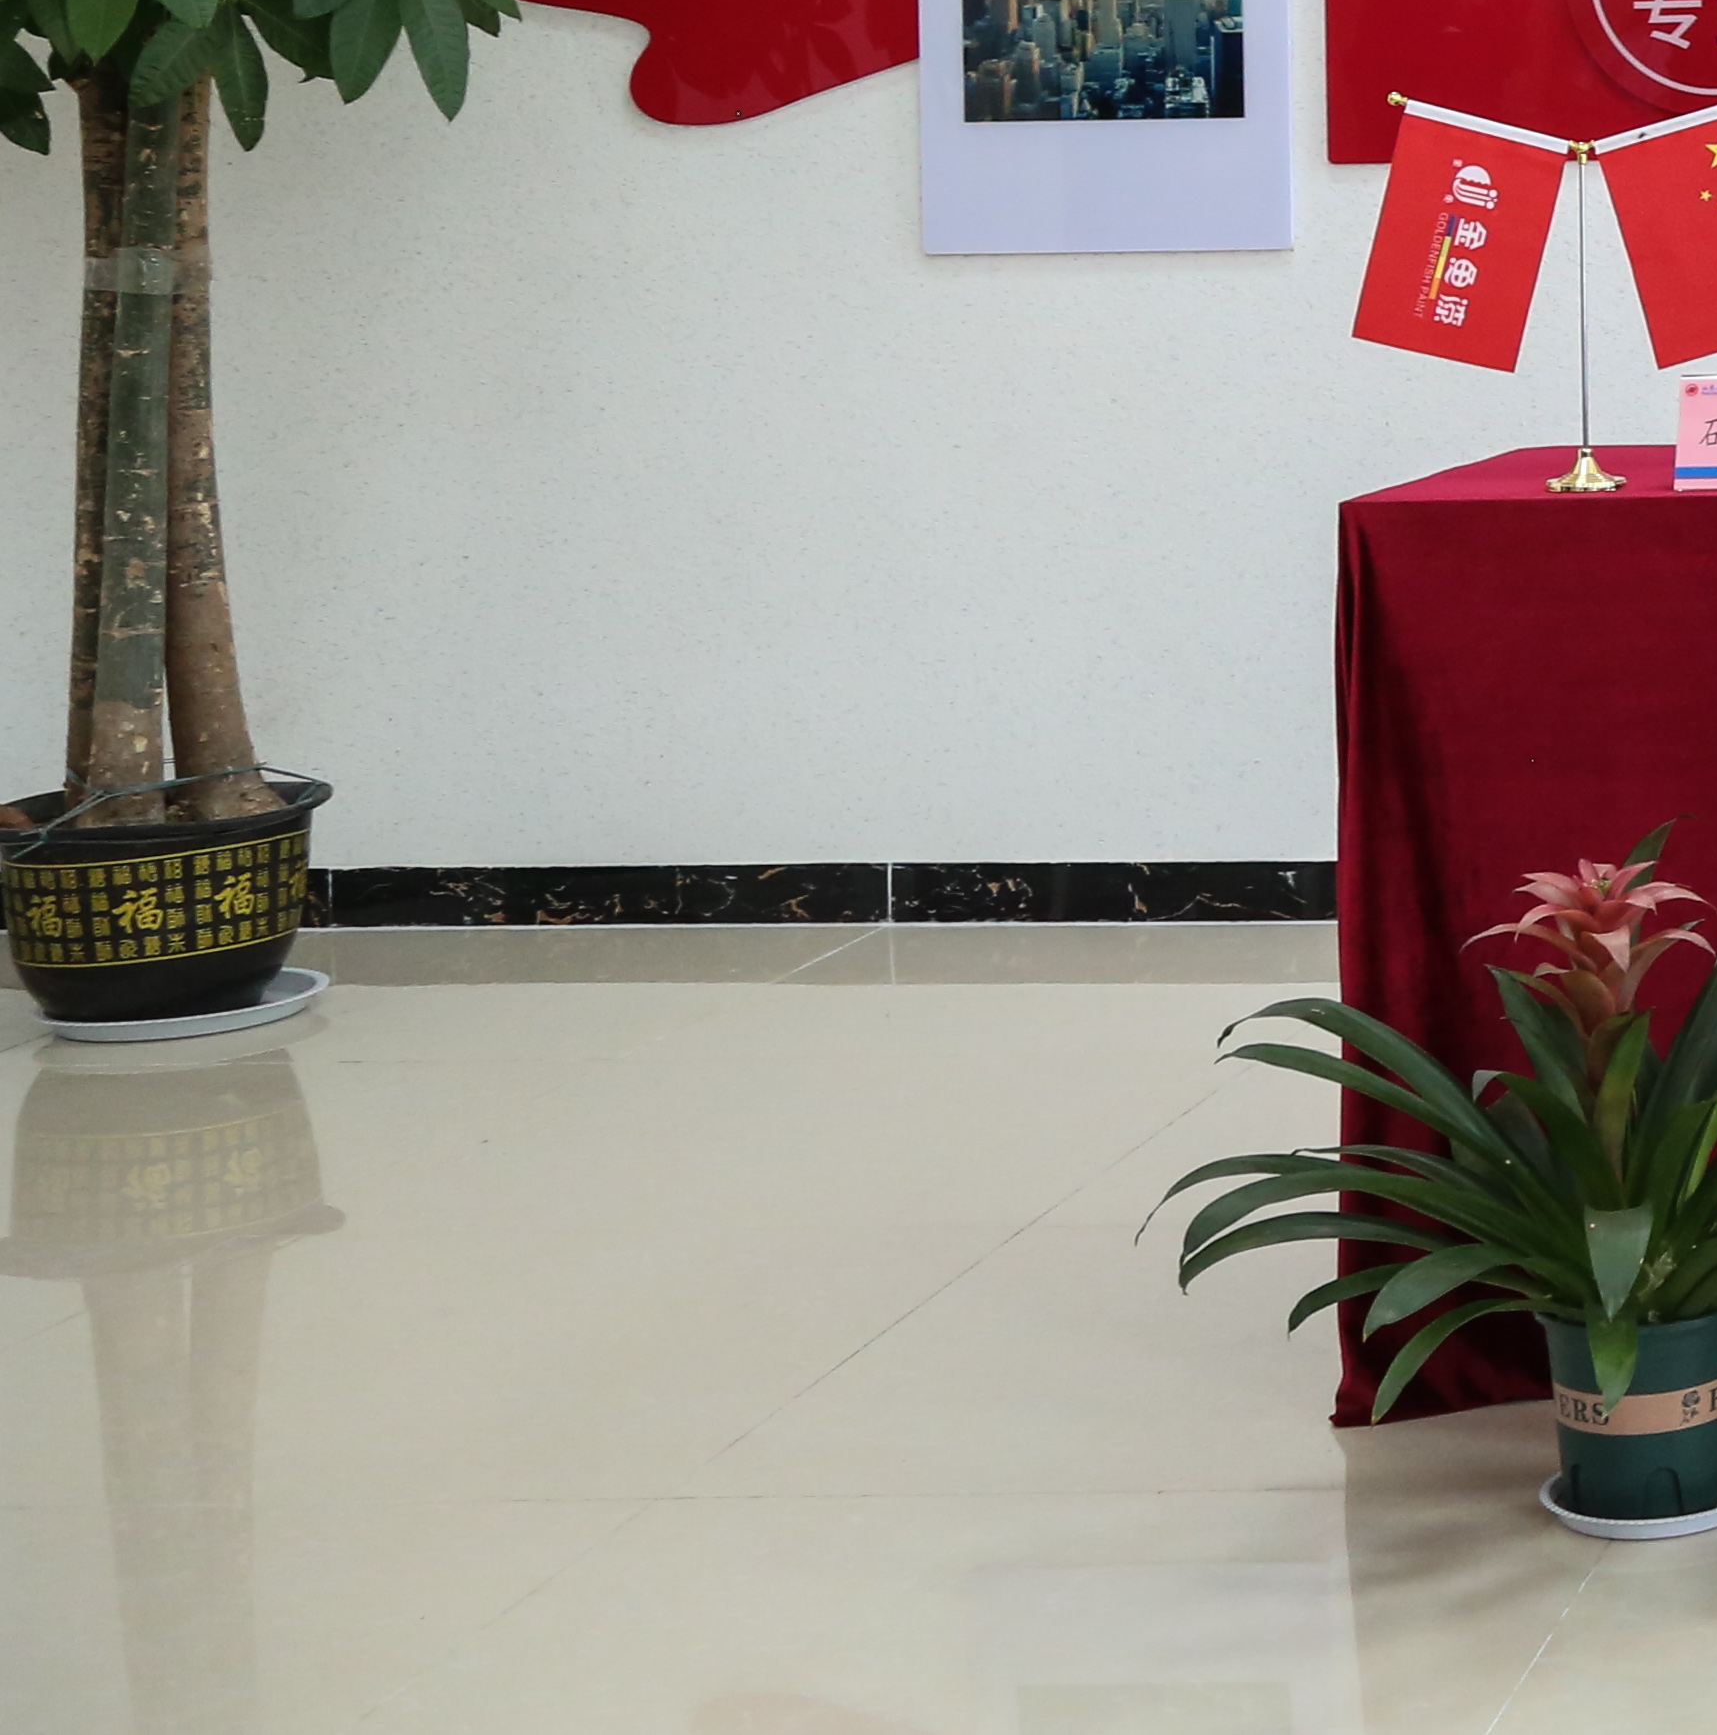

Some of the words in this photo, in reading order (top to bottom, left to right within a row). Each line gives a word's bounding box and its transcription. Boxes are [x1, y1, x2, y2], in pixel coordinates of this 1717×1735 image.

[1421, 213, 1449, 284] GOLDENFISH
[1433, 218, 1488, 327] 金鱼漆
[1414, 286, 1429, 318] PAINT
[26, 894, 63, 937] 福
[112, 887, 165, 934] 福
[214, 875, 256, 919] 福
